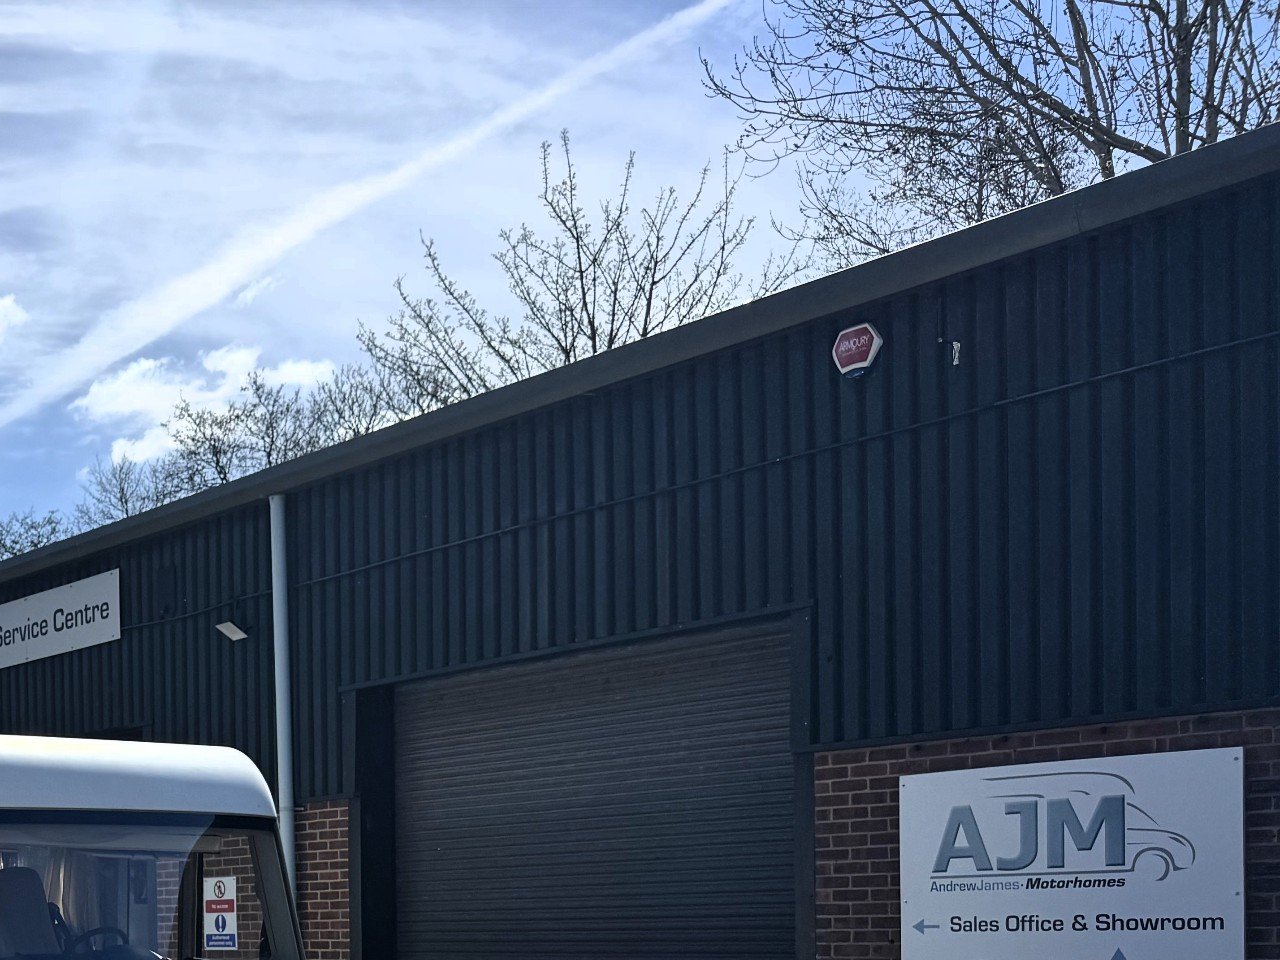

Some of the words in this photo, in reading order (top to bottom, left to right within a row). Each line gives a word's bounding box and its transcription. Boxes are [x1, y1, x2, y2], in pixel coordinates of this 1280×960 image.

[53, 601, 110, 633] Centre
[931, 794, 1126, 873] AJM
[949, 915, 1000, 932] Sales
[1005, 914, 1065, 932] Office
[1071, 914, 1089, 931] &
[1095, 913, 1225, 931] Showroom
